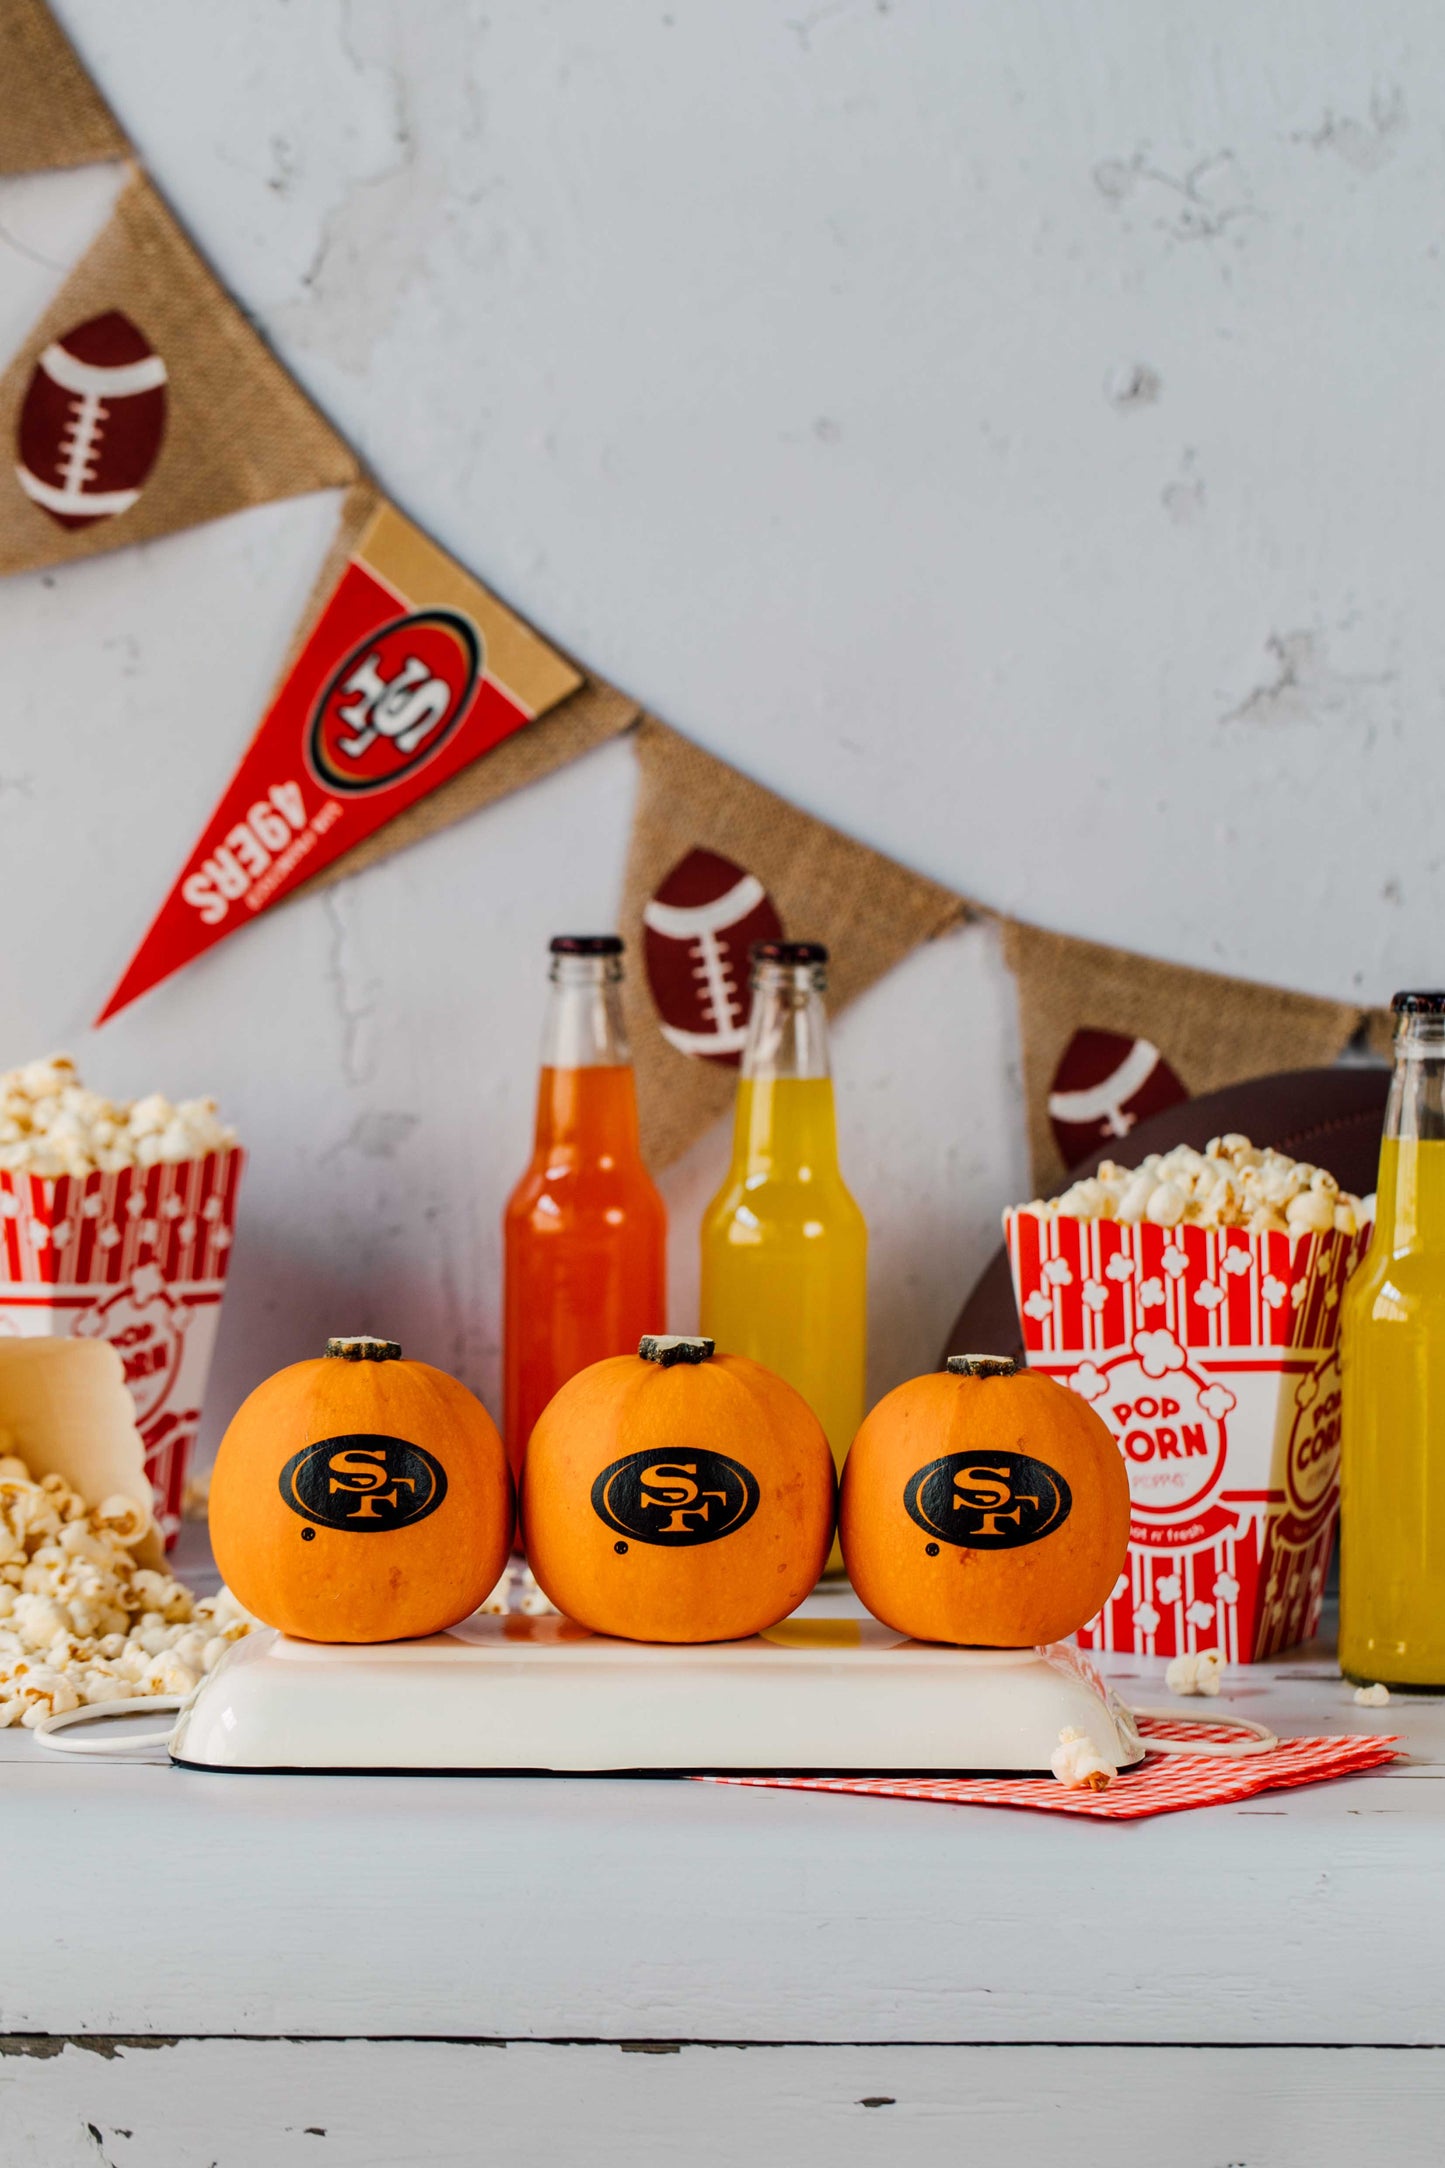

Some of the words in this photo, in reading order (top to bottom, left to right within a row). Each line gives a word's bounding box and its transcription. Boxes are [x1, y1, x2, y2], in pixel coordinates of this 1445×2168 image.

[181, 780, 307, 925] 49ERS
[1112, 1396, 1180, 1427] POP
[1113, 1422, 1208, 1462] ORN
[328, 1449, 415, 1518] SF
[640, 1463, 727, 1533] SF
[953, 1466, 1039, 1535] SF
